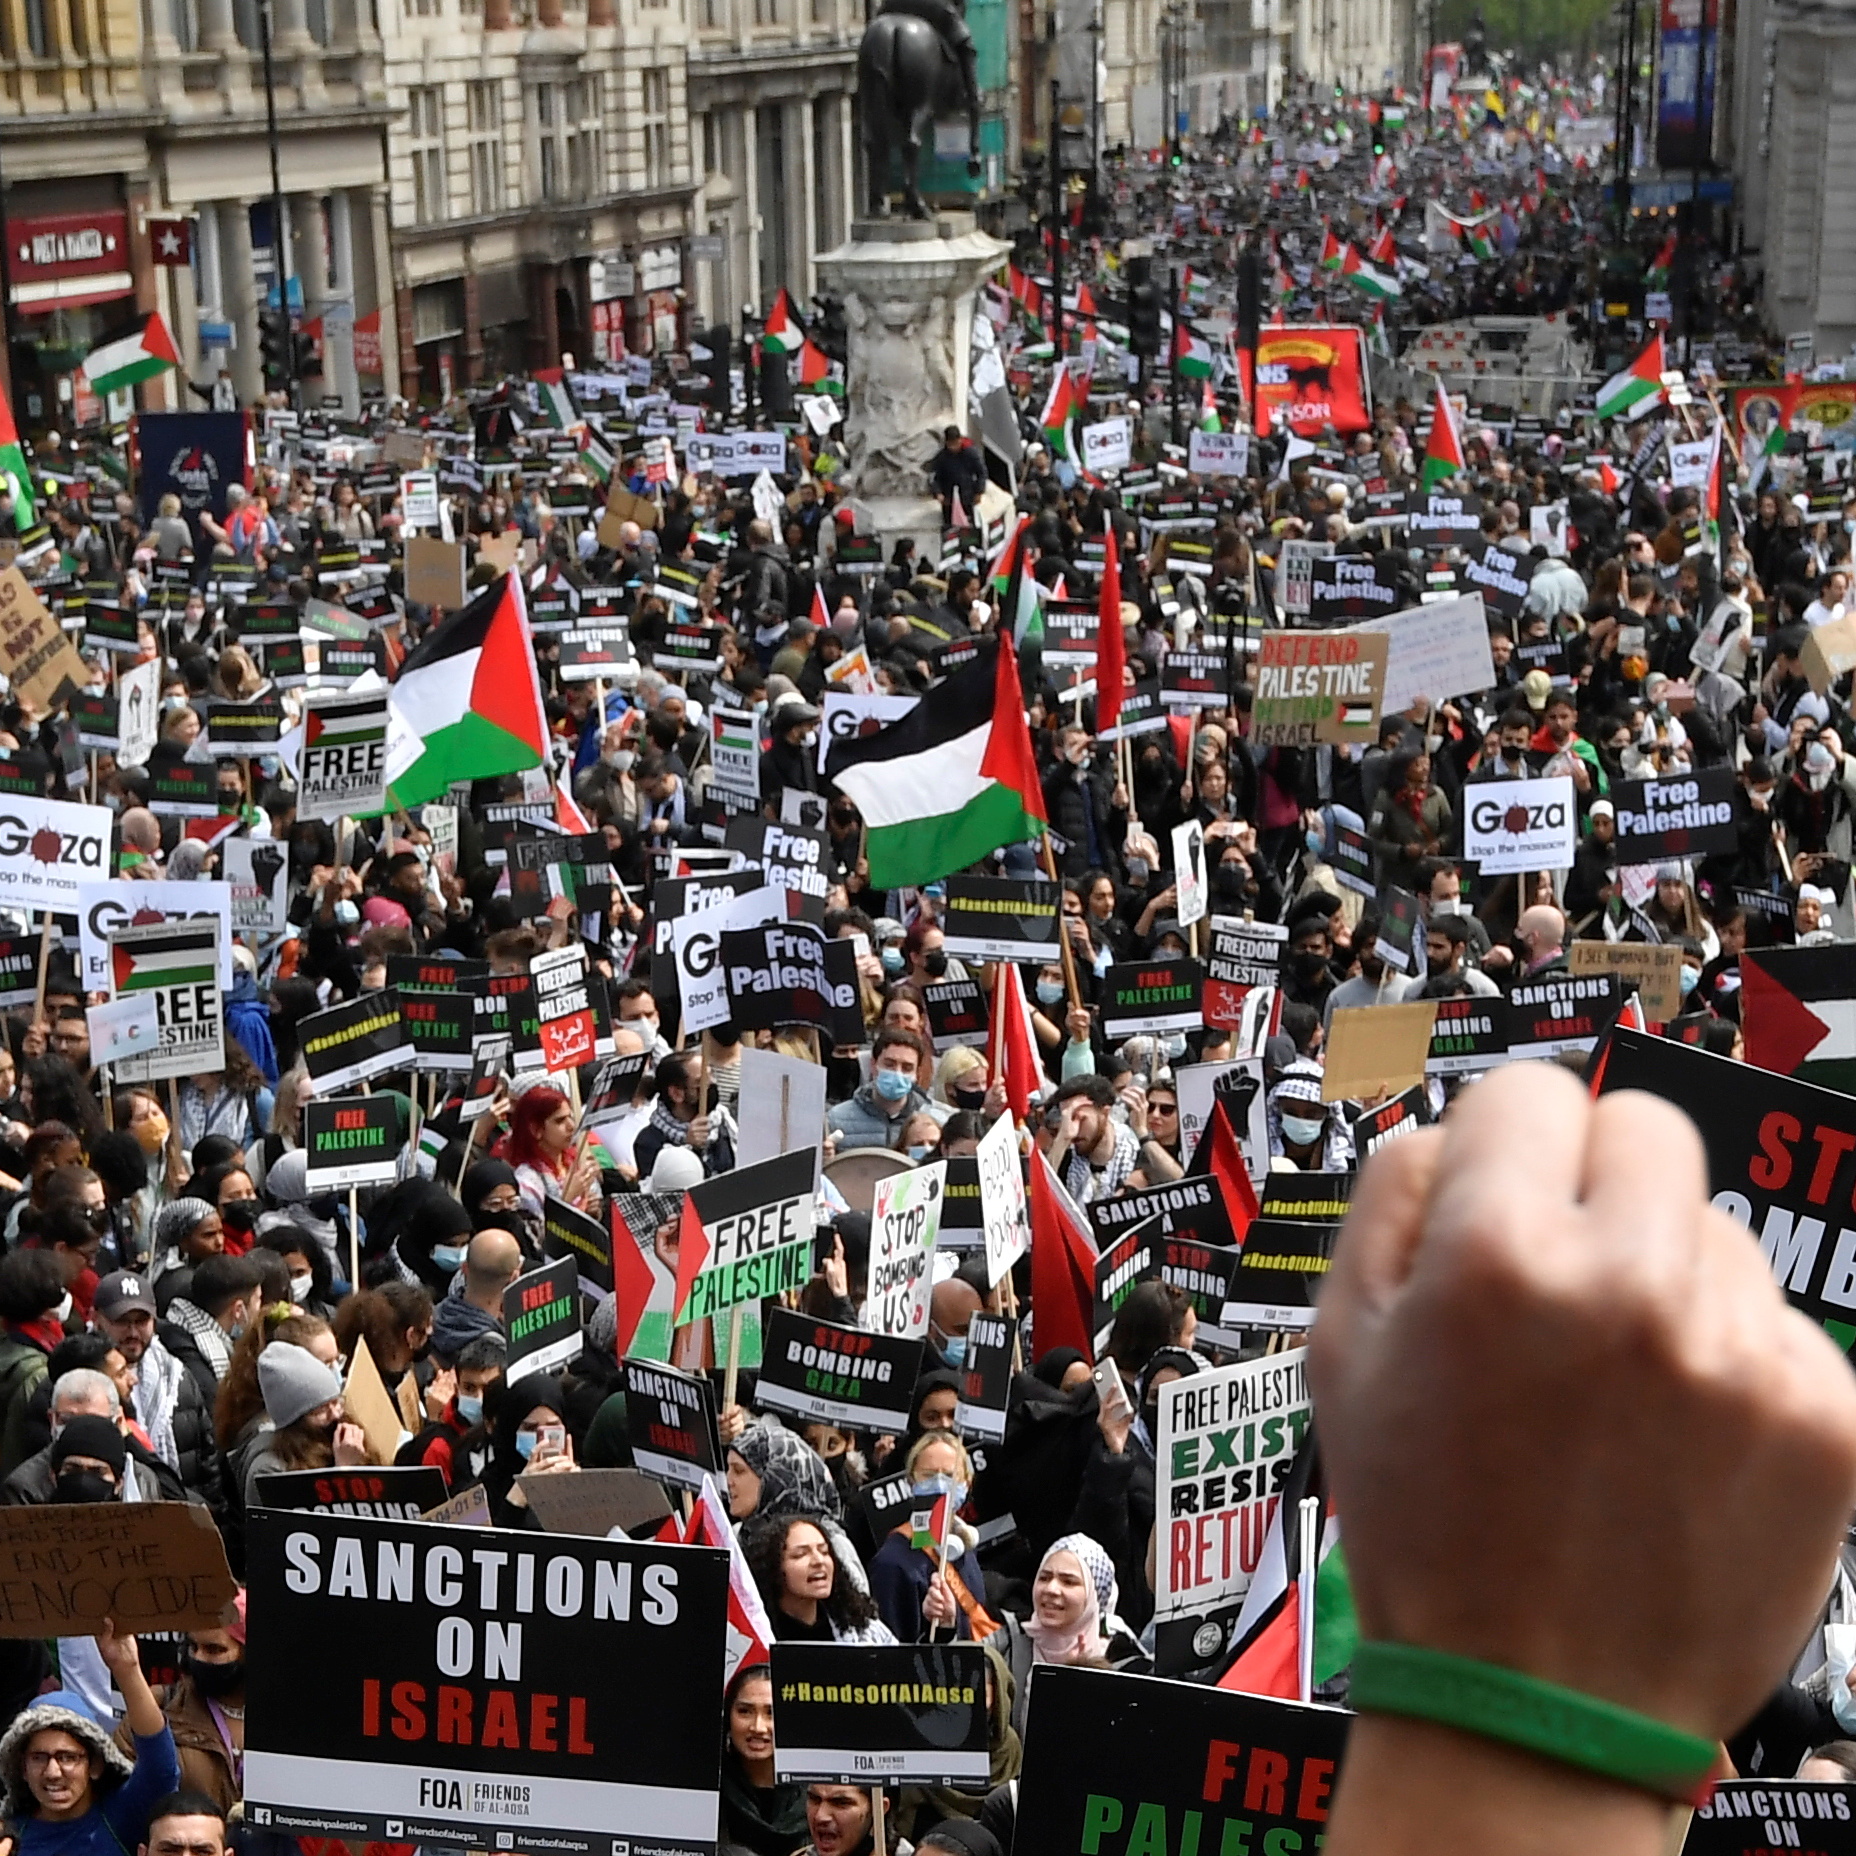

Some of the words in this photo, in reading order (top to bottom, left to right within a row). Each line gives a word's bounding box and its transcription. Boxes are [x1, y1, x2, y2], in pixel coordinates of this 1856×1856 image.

[1263, 637, 1359, 664] DEFEND
[1258, 661, 1373, 699] PALESTINE
[304, 743, 385, 778] FREE
[302, 771, 383, 796] PALESTINE
[1644, 777, 1699, 804] Free
[1471, 801, 1565, 834] Gza
[1617, 798, 1732, 838] Palestine
[1215, 933, 1279, 961] FREEDOM
[1209, 960, 1280, 986] PALESTINE
[334, 1108, 367, 1130] FREE
[315, 1126, 387, 1151] PALESTINE
[713, 1198, 800, 1265] FREE
[880, 1205, 927, 1256] STOP
[689, 1238, 810, 1321] PALESTINE
[872, 1244, 926, 1304] BOMBING
[522, 1281, 555, 1309] FREE
[882, 1284, 912, 1336] US
[509, 1295, 573, 1340] PALESTINE
[814, 1326, 871, 1355] STOP
[787, 1339, 893, 1383] BOMBING
[627, 1368, 700, 1412] SANCTIONS
[805, 1369, 862, 1399] GAZA
[1170, 1384, 1222, 1433] FREE
[1227, 1364, 1308, 1411] PALESTI
[660, 1403, 680, 1428] ON
[649, 1423, 696, 1457] ISRAEL
[1169, 1460, 1291, 1518] RESIS
[13, 1548, 82, 1573] END
[87, 1544, 166, 1568] THE
[1169, 1501, 1279, 1592] RETU
[284, 1532, 679, 1626] SANCTIONS
[436, 1617, 521, 1681] ON
[781, 1682, 975, 1705] #HandsOffAlAqsa
[363, 1678, 594, 1755] ISRAEL
[418, 1778, 463, 1811] FOA
[474, 1783, 531, 1804] FRIENDS
[1202, 1739, 1336, 1821] FRE
[275, 1813, 367, 1832] foapeaceinpalestine
[474, 1801, 488, 1813] OF
[490, 1801, 531, 1816] AL-AQSA
[407, 1825, 477, 1843] friendsofalaqsa
[517, 1835, 589, 1852] friendsofalaqsa
[1765, 1818, 1801, 1848] ON
